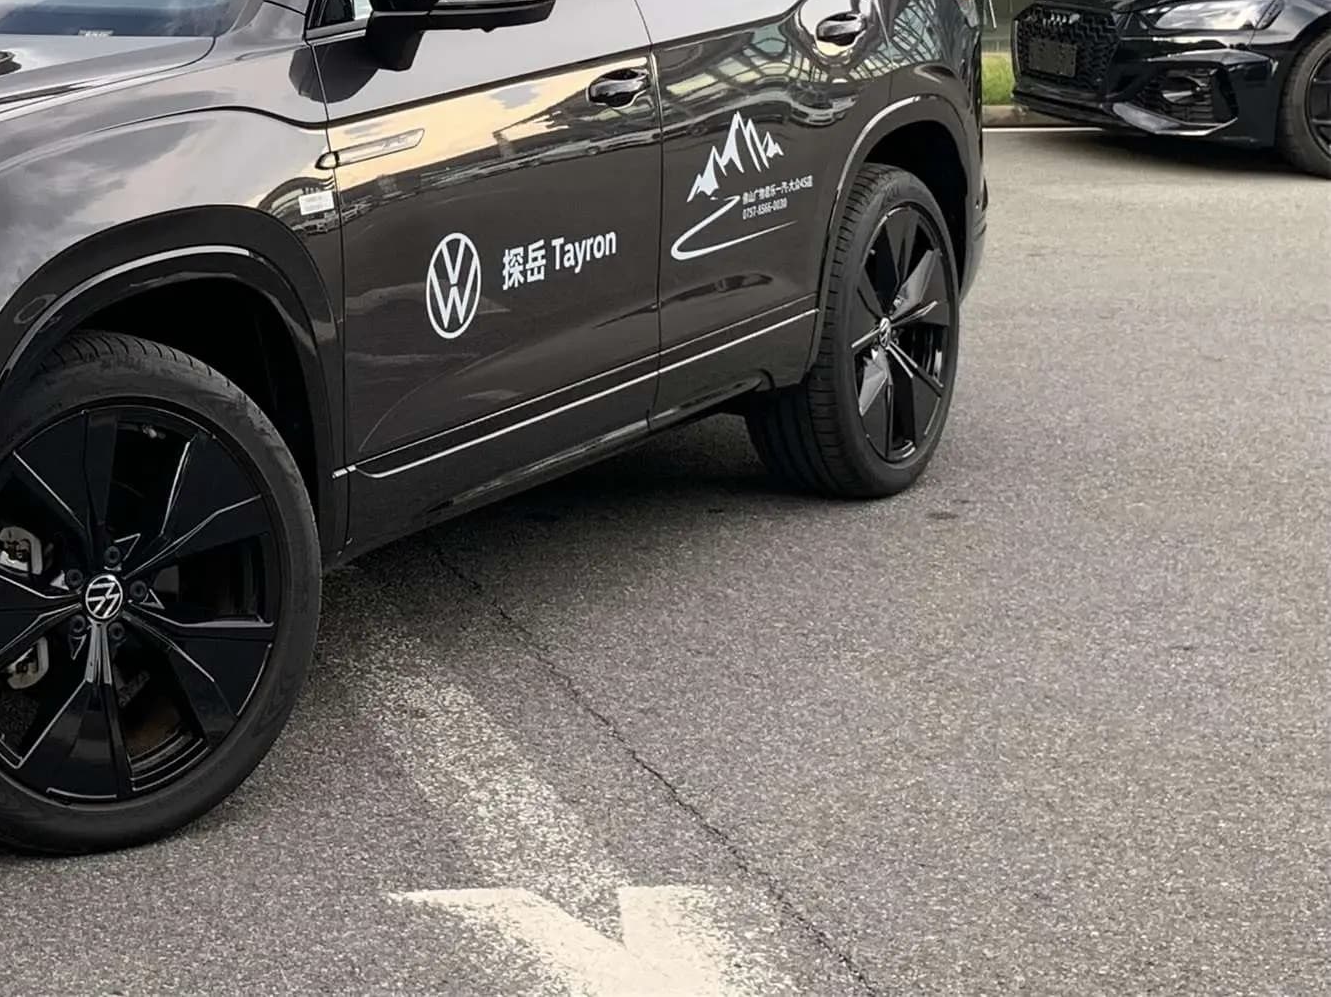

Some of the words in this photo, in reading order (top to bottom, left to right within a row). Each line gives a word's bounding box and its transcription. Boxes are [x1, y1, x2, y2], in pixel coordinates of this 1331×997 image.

[426, 232, 481, 339] VW
[501, 238, 547, 291] 探岳
[551, 231, 617, 274] Tayron
